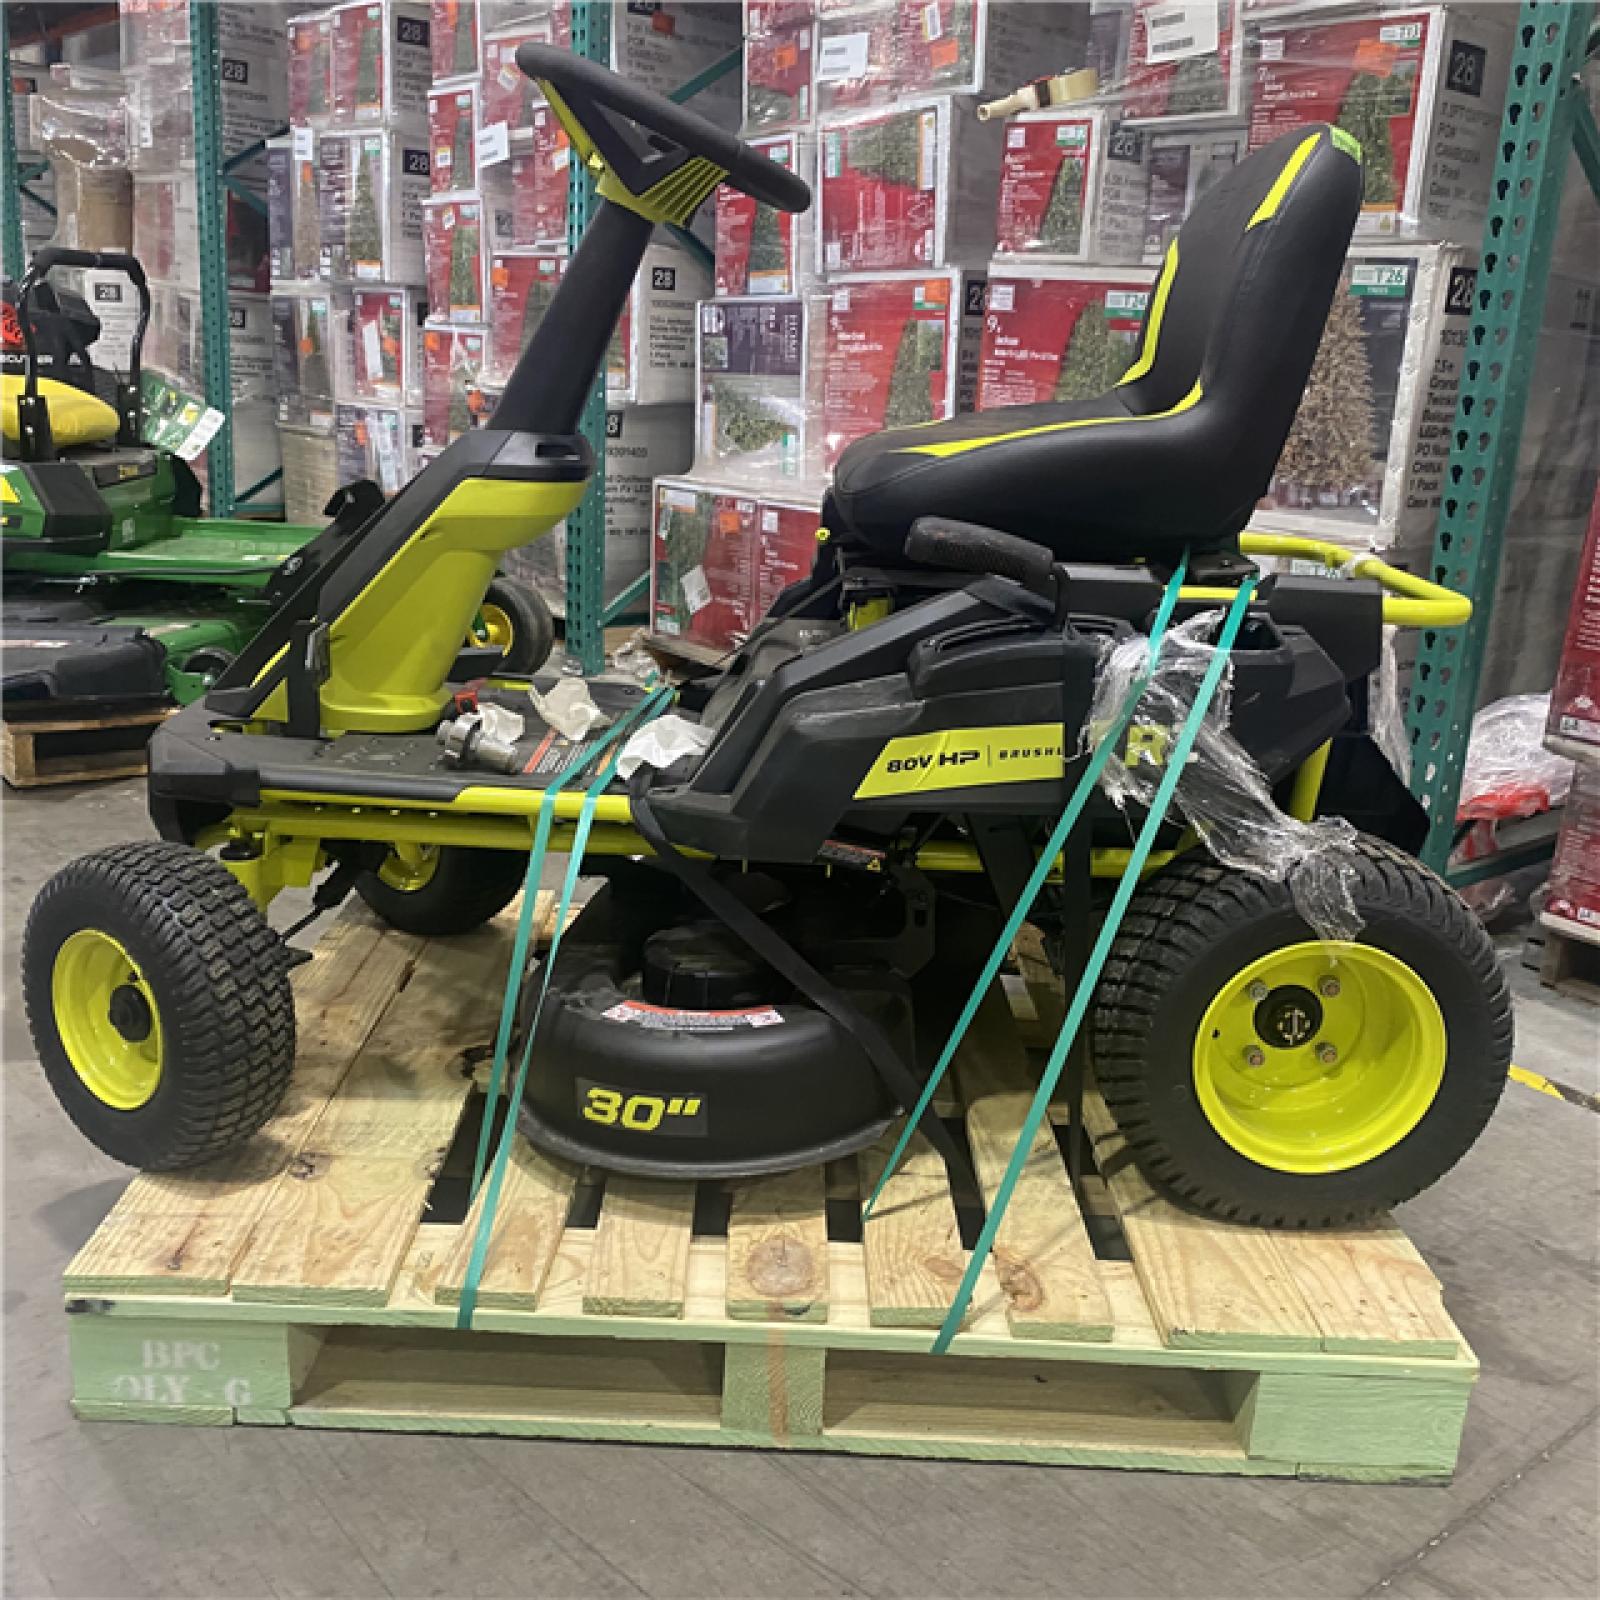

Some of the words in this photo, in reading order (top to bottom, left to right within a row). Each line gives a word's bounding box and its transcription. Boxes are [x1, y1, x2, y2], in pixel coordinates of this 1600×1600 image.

[886, 754, 933, 774] 80V
[938, 749, 981, 767] HP
[582, 1086, 701, 1132] 30"
[141, 1339, 222, 1372] BPC
[225, 1376, 254, 1406] G
